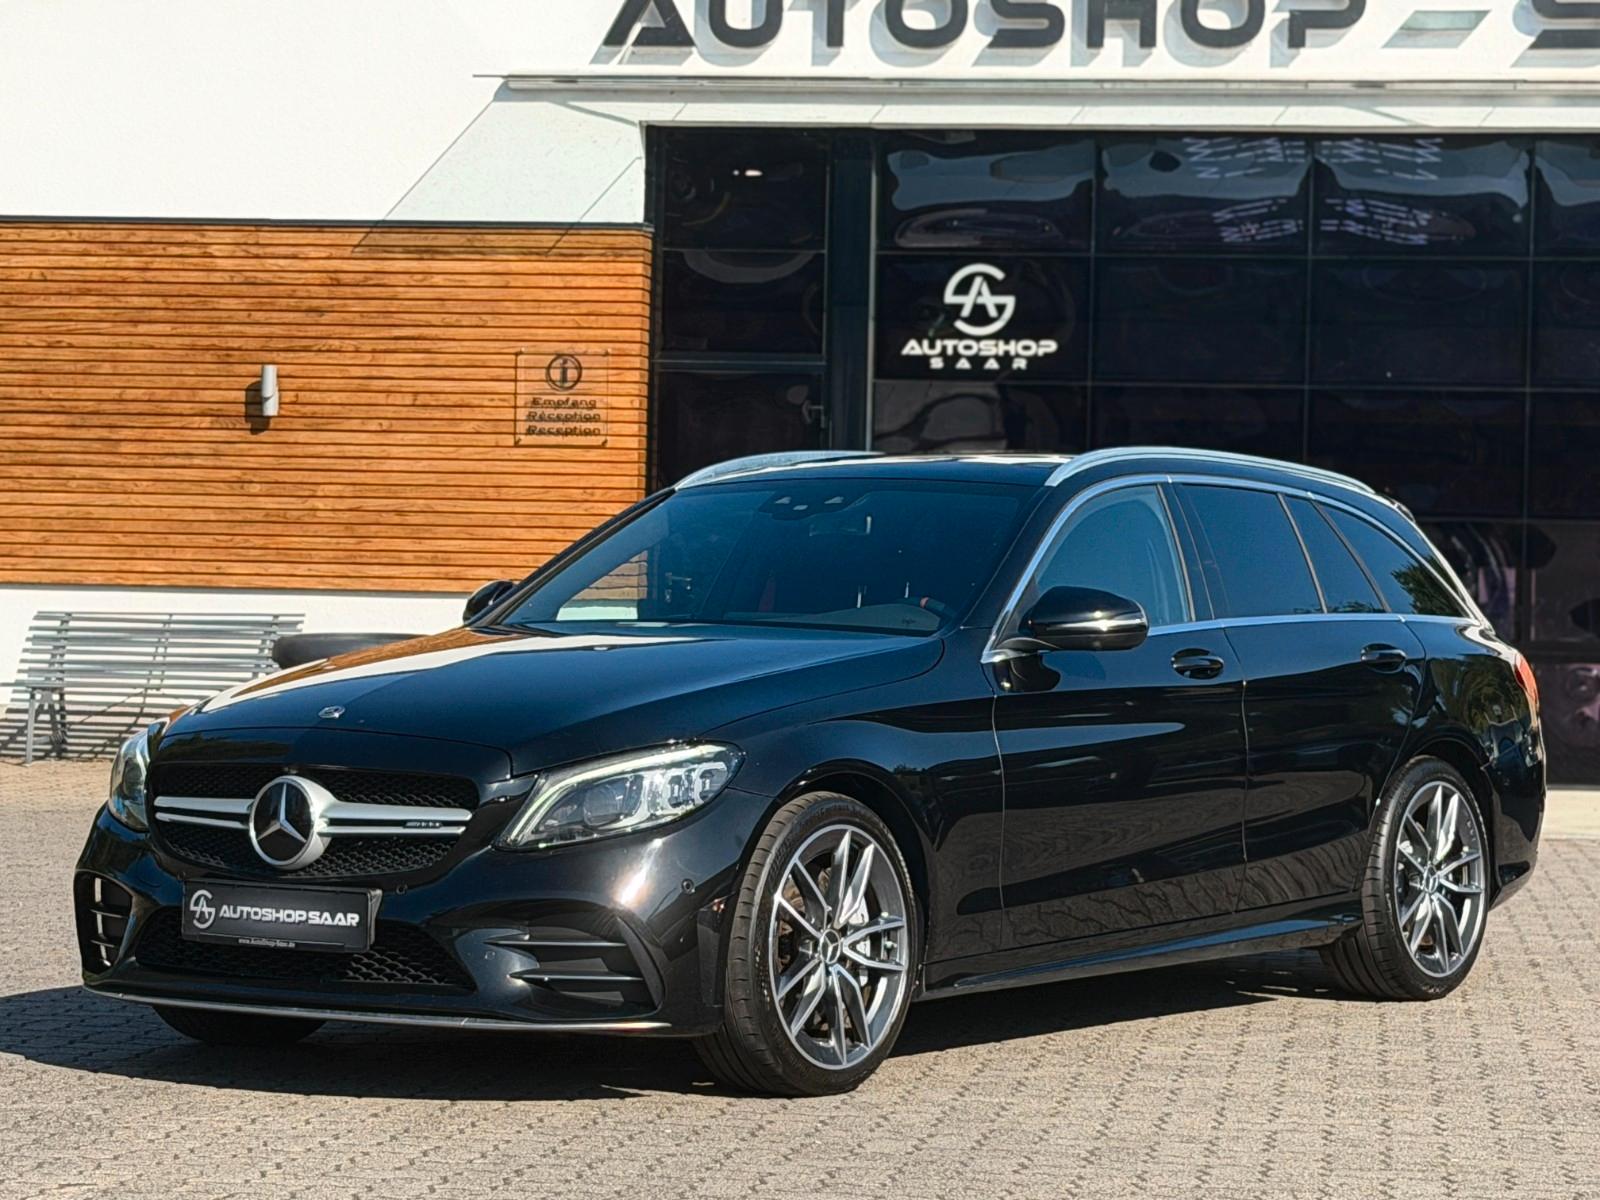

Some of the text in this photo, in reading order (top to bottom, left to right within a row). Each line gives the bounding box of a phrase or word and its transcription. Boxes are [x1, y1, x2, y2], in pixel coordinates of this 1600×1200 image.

[601, 0, 1366, 49] AUTOSHOP
[901, 338, 1058, 356] AUTOSHOP
[929, 356, 1028, 370] SAAR
[531, 397, 597, 410] Empfang
[526, 424, 601, 438] Reception
